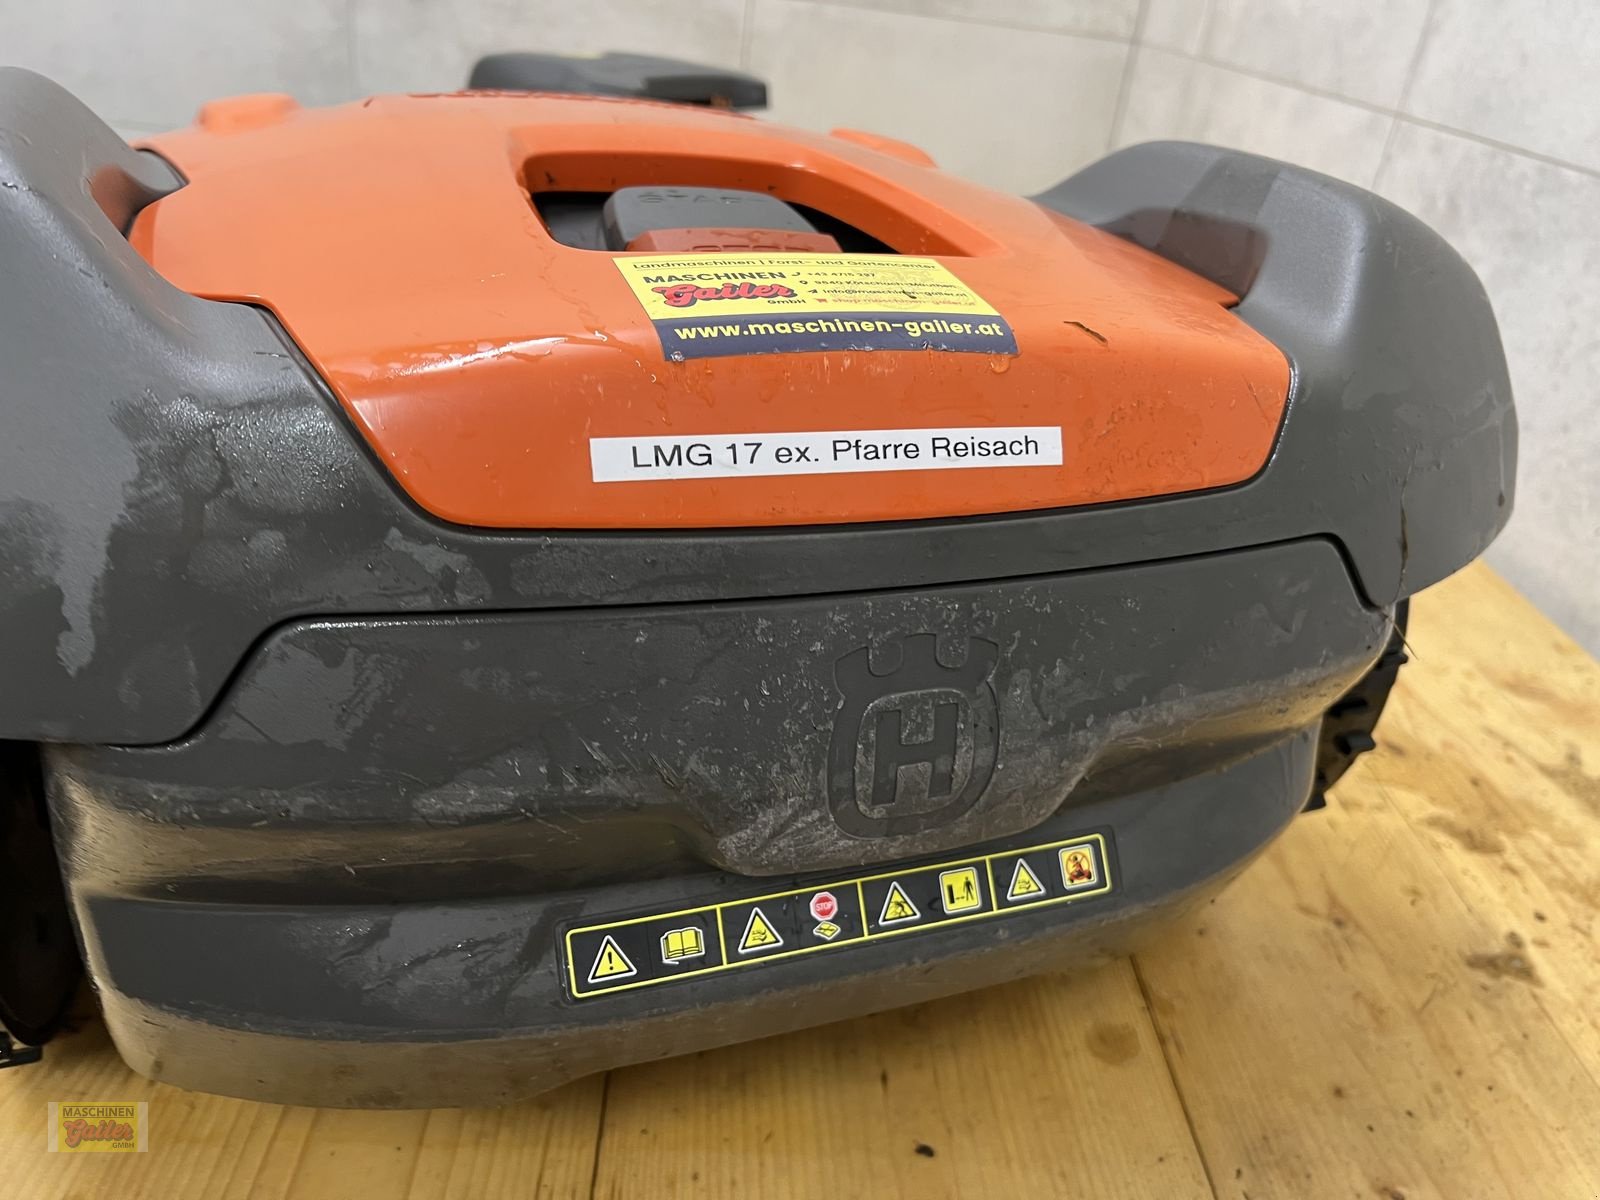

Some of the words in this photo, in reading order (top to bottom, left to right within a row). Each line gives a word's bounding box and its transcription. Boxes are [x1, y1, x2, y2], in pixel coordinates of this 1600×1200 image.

[633, 259, 756, 269] Landmaschinen
[847, 260, 936, 269] Gartencenter
[643, 271, 787, 284] MASCHINEN
[651, 282, 798, 308] Gailer
[674, 318, 1004, 340] www.maschinen-gailer.at
[631, 443, 713, 468] LMG
[726, 442, 763, 465] 17
[774, 446, 820, 464] ex.
[832, 439, 920, 461] Pfarre
[931, 435, 1039, 458] Reisach
